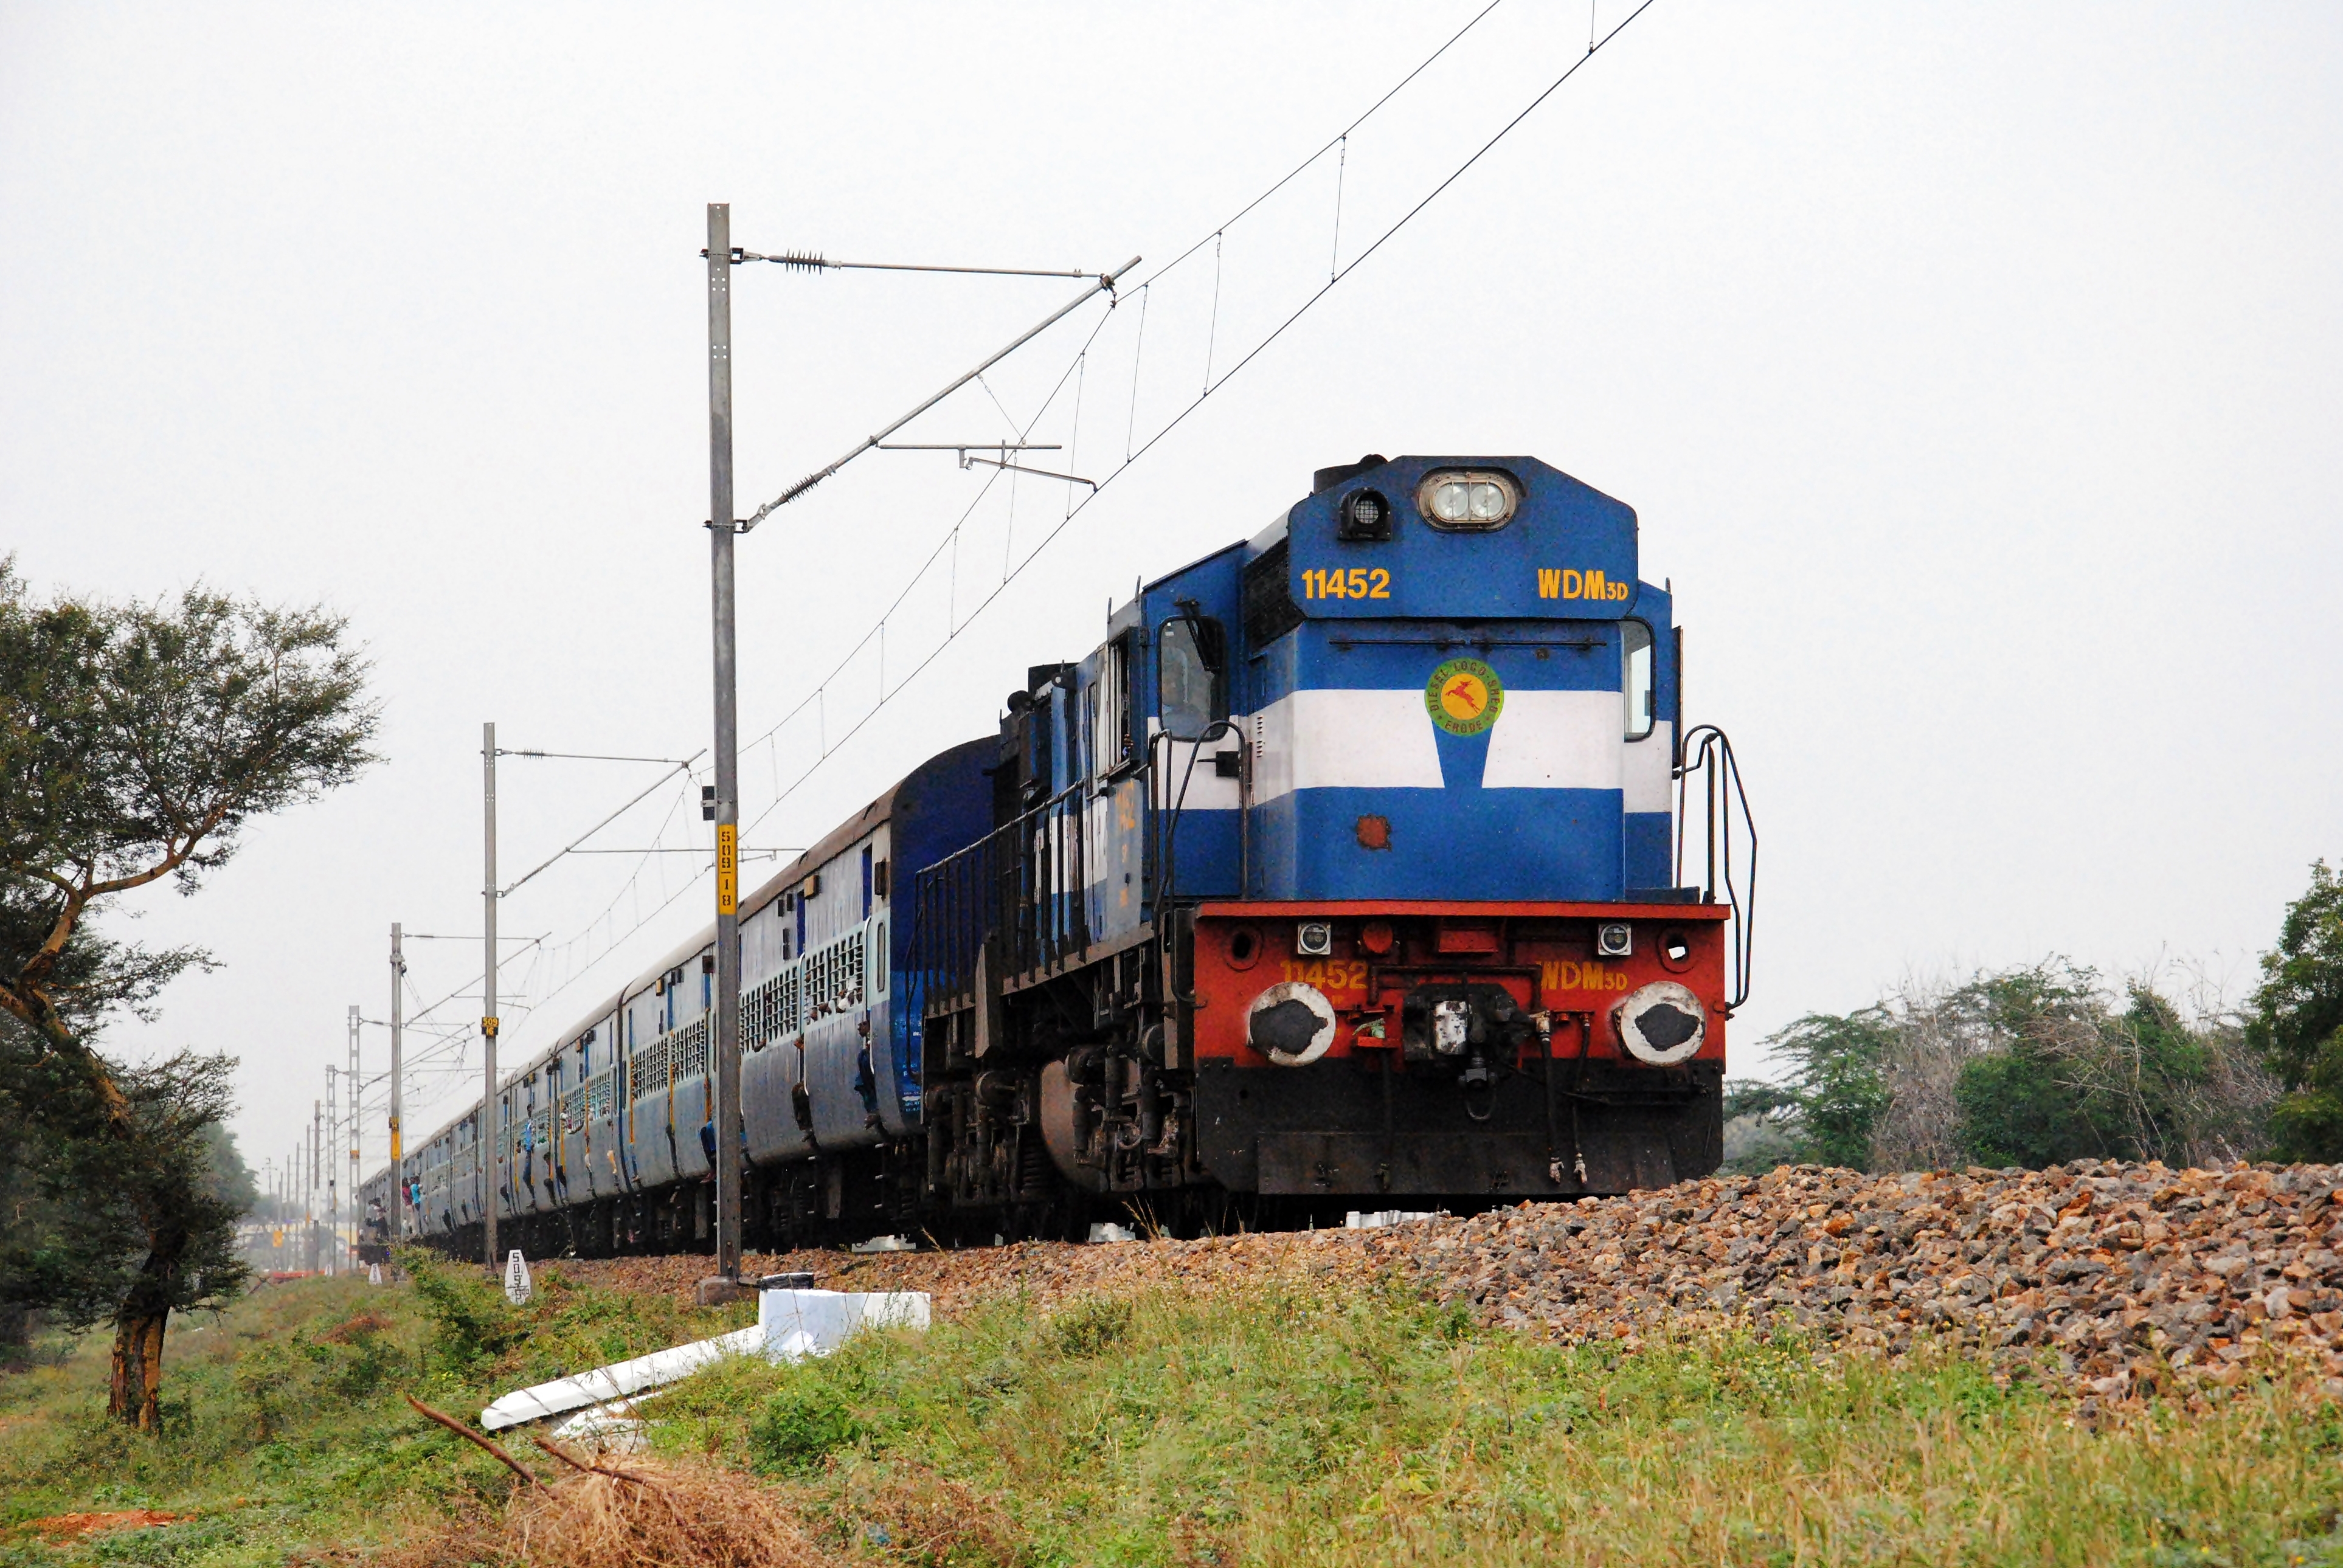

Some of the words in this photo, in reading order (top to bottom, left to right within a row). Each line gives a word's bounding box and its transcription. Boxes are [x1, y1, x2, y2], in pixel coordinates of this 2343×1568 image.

[1301, 568, 1390, 600] 11452
[1428, 669, 1448, 711] DIESEL
[1453, 660, 1487, 676] LOCO
[1487, 680, 1500, 713] SHED
[1445, 720, 1483, 733] ERODE
[1280, 959, 1368, 990] 11452
[483, 1017, 498, 1026] 509
